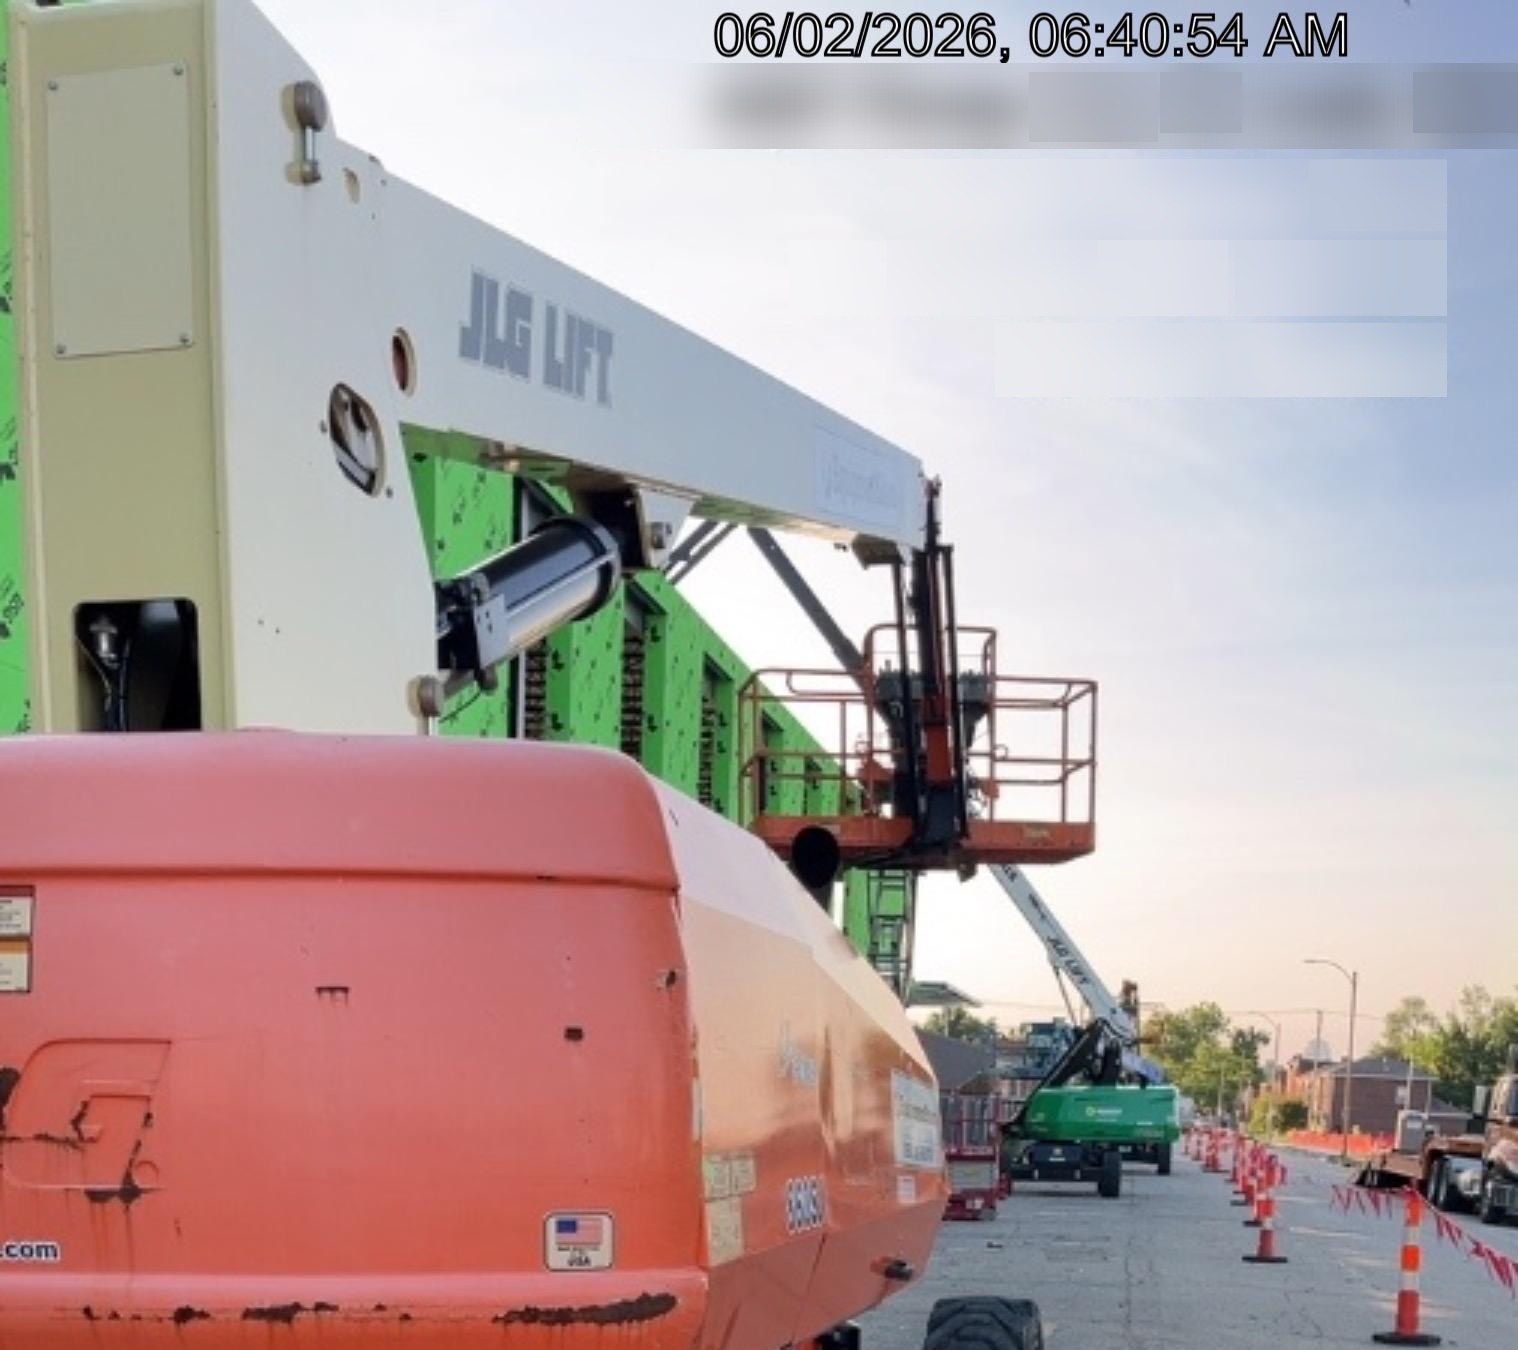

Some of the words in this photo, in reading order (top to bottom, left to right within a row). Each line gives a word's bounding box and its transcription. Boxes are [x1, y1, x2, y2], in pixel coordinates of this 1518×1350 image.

[459, 271, 533, 381] JLG
[543, 303, 614, 404] LIFT
[567, 1256, 592, 1267] USA
